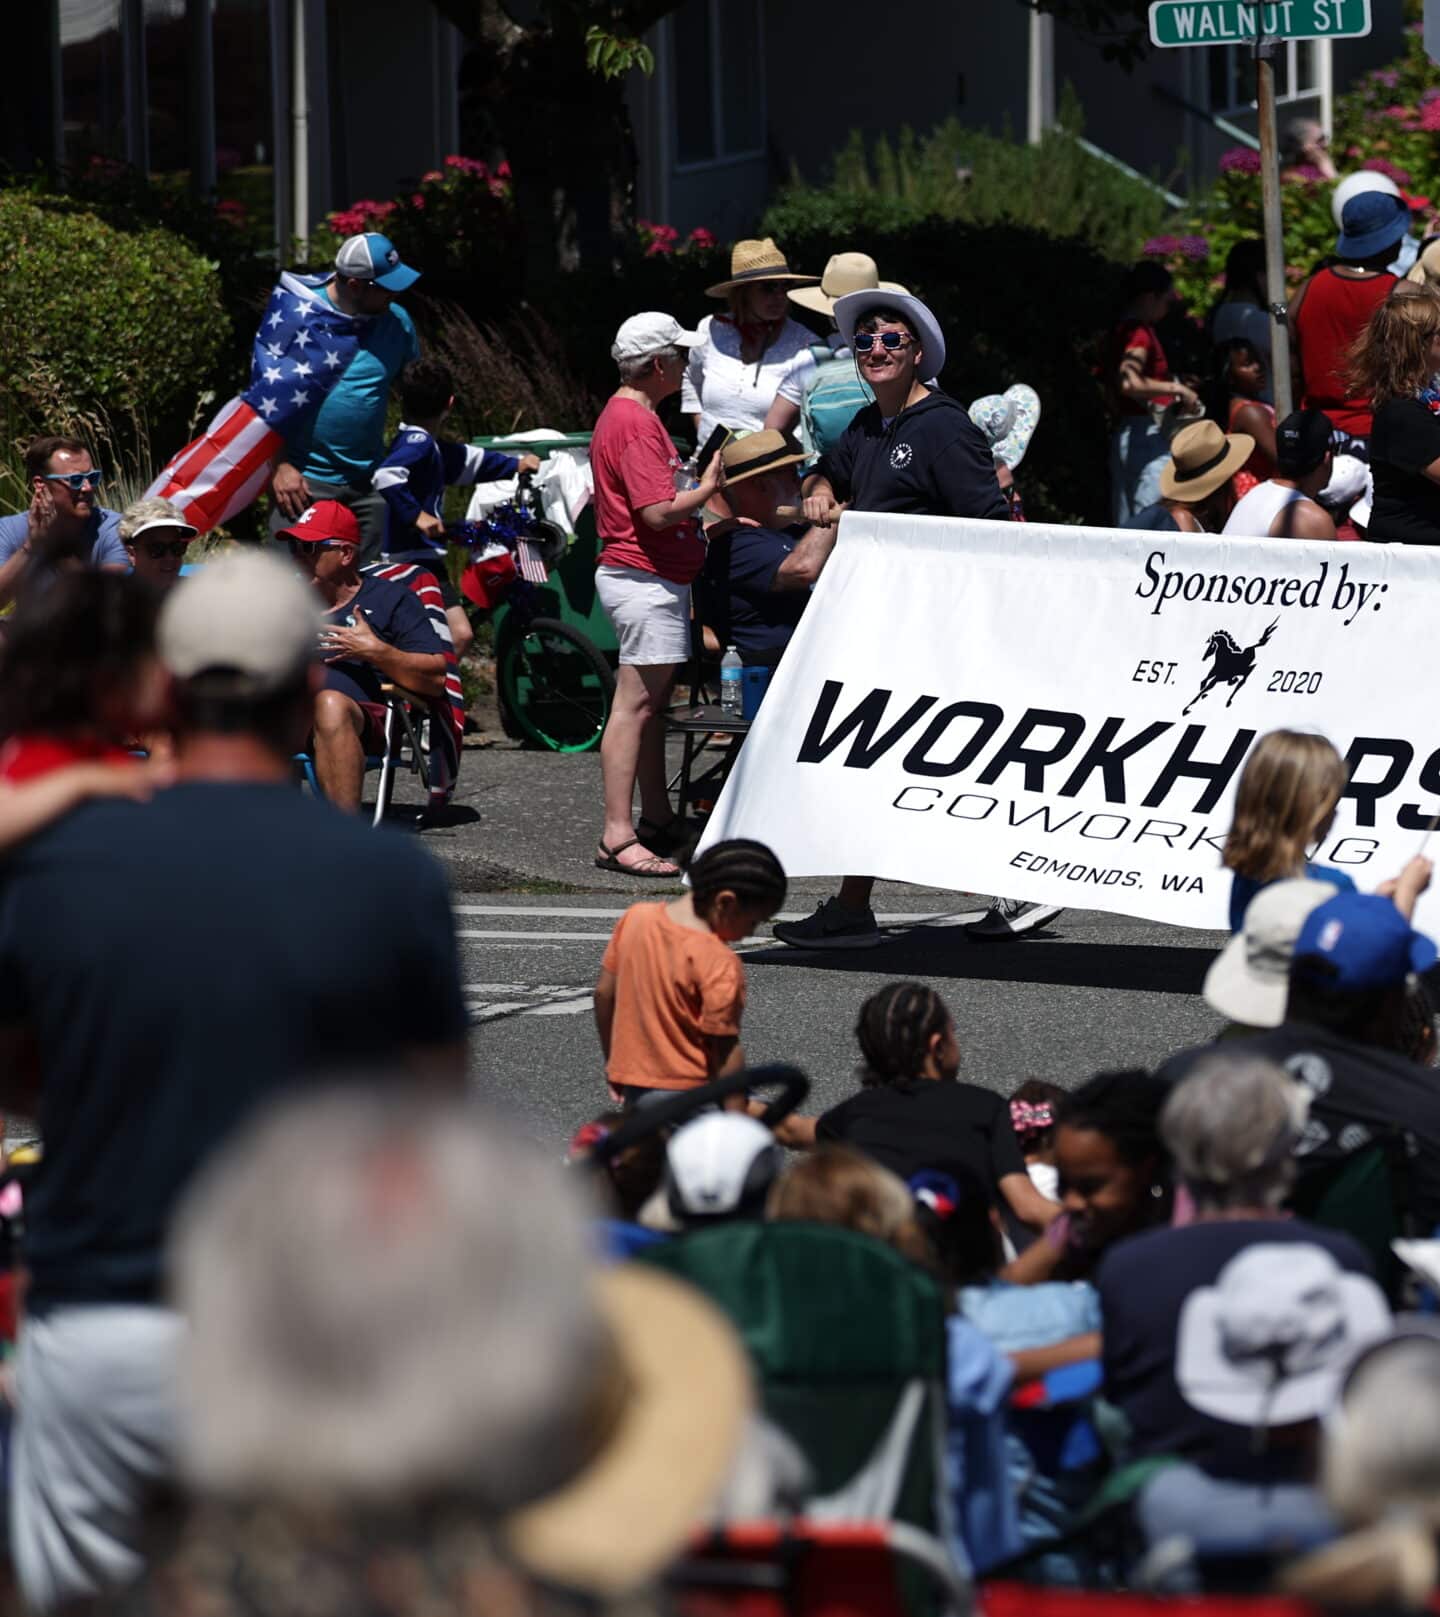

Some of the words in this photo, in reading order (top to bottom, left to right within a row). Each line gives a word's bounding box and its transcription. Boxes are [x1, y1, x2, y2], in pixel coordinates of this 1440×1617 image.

[1173, 1, 1295, 39] WALNUT
[1313, 0, 1346, 31] ST
[1135, 551, 1329, 615] Sponsored
[1331, 563, 1389, 626] by:
[1132, 660, 1178, 685] EST.
[1267, 670, 1323, 694] 2020
[893, 786, 1380, 864] COWORKG
[1161, 874, 1204, 894] WA
